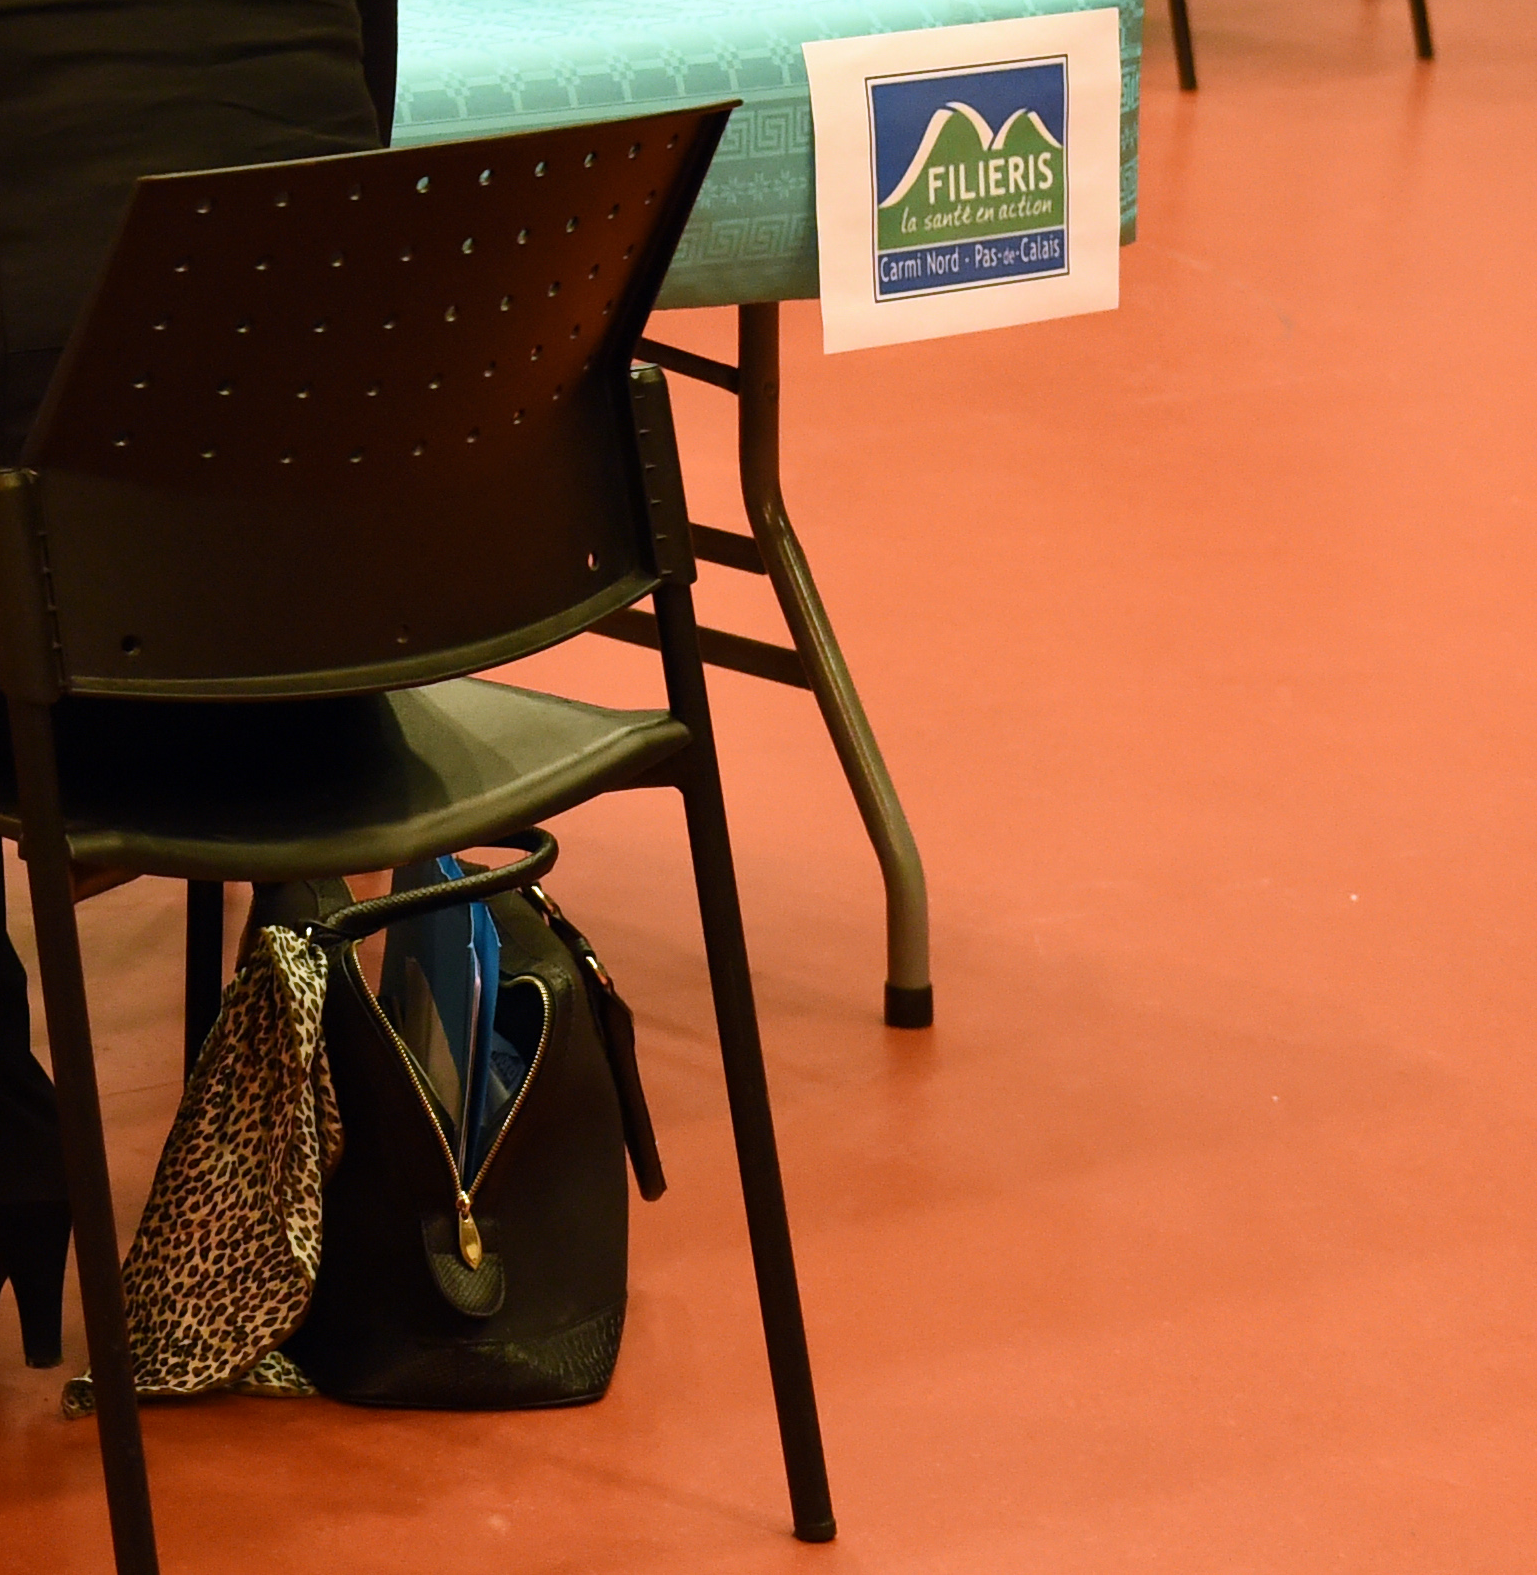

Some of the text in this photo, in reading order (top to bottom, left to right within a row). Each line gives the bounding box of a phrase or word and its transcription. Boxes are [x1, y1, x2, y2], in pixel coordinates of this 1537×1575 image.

[928, 152, 1054, 205] FILIERIS
[901, 195, 1053, 234] la santé en action
[880, 253, 922, 283] Carmi
[927, 247, 960, 276] Nord
[975, 234, 1061, 270] Pas-de-Calais
